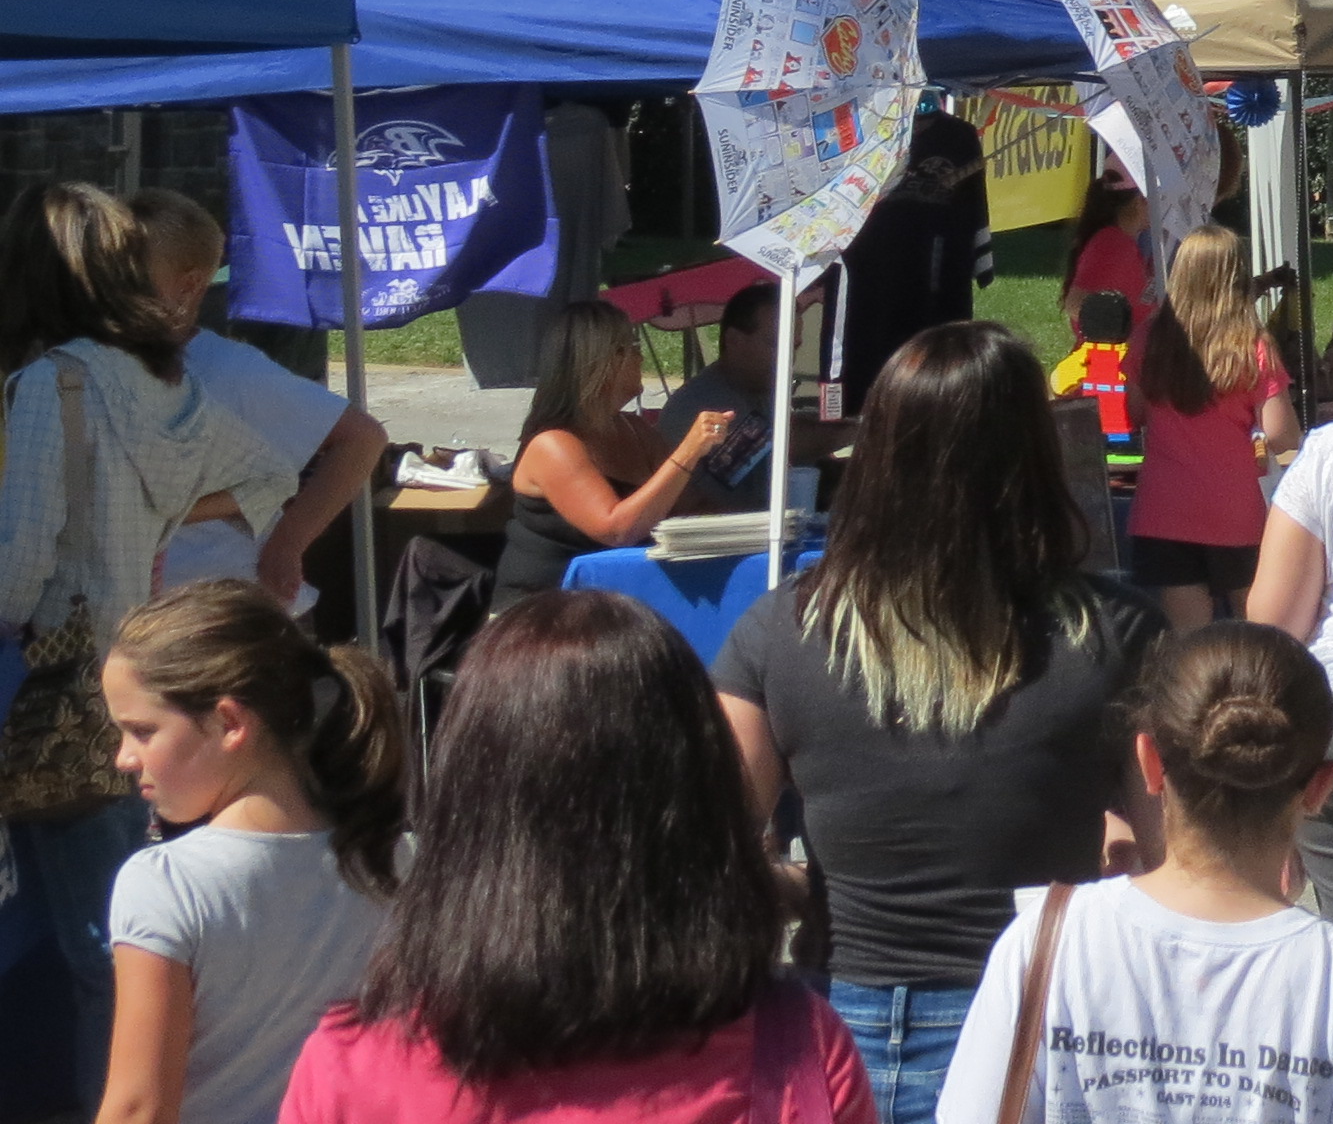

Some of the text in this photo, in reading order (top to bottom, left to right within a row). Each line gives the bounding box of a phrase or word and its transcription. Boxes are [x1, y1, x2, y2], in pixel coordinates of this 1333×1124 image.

[1049, 1025, 1208, 1066] Reflections
[1217, 1042, 1247, 1069] In
[1082, 1068, 1302, 1113] PASSPORT TO DANCE
[1155, 1090, 1232, 1109] CAST 2014
